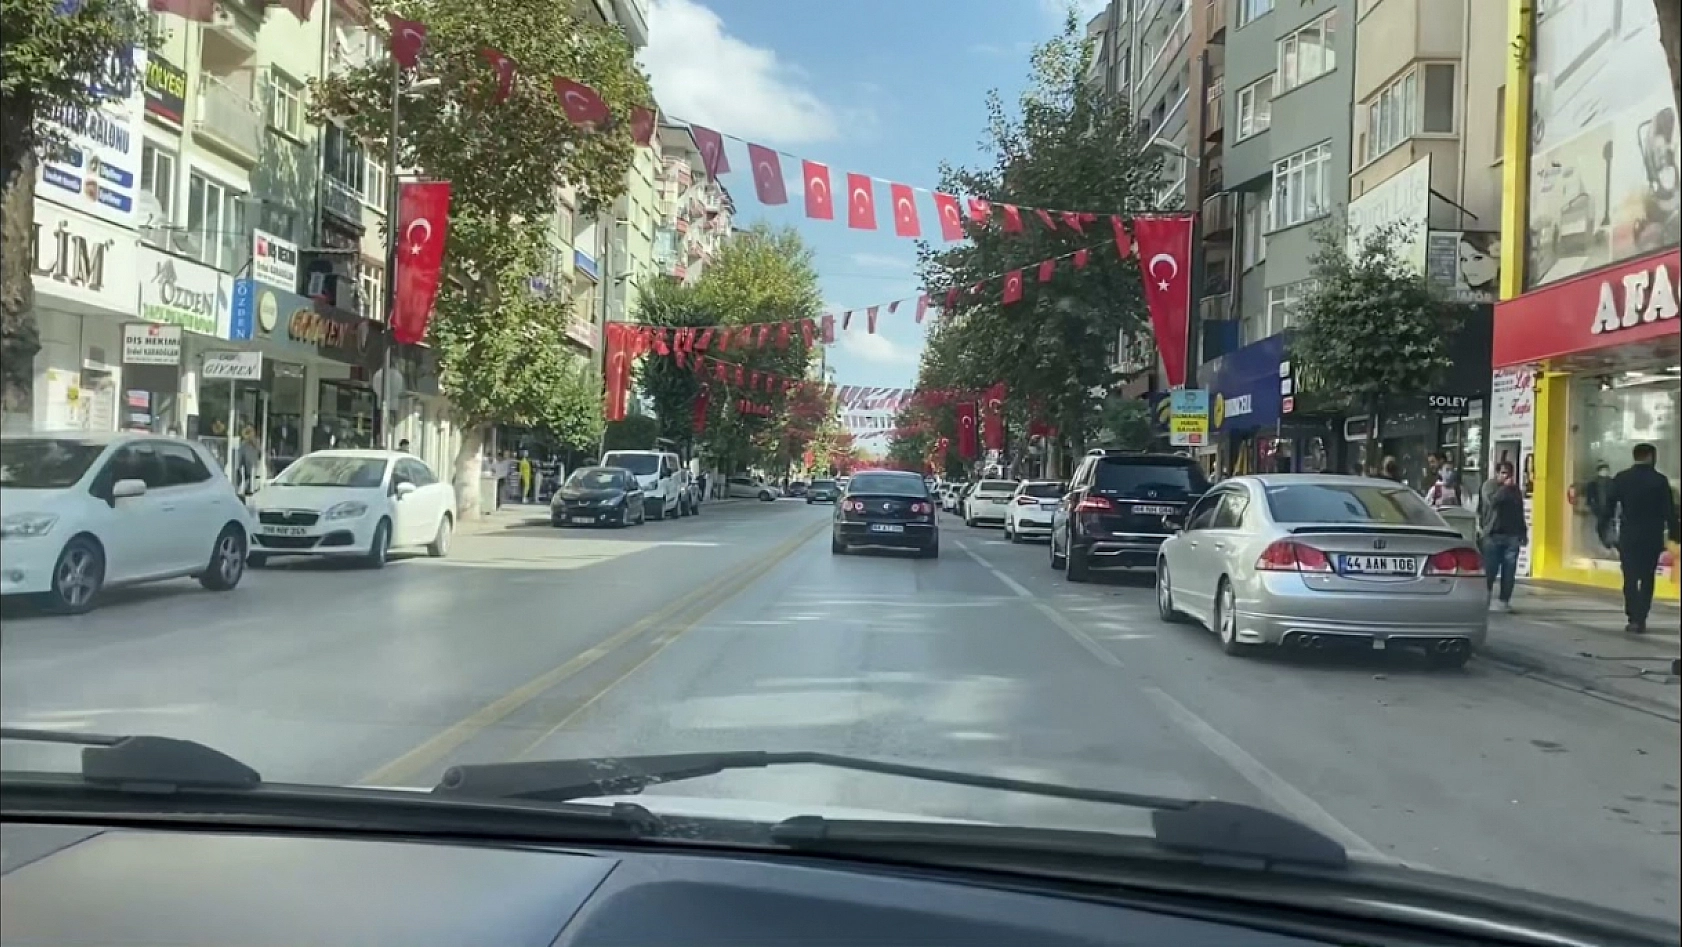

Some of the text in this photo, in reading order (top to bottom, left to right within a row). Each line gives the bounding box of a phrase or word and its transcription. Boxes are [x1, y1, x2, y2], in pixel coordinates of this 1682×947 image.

[1591, 264, 1680, 334] AFA
[1428, 395, 1467, 407] SOLEY
[1347, 556, 1415, 571] 44 AAN 106
